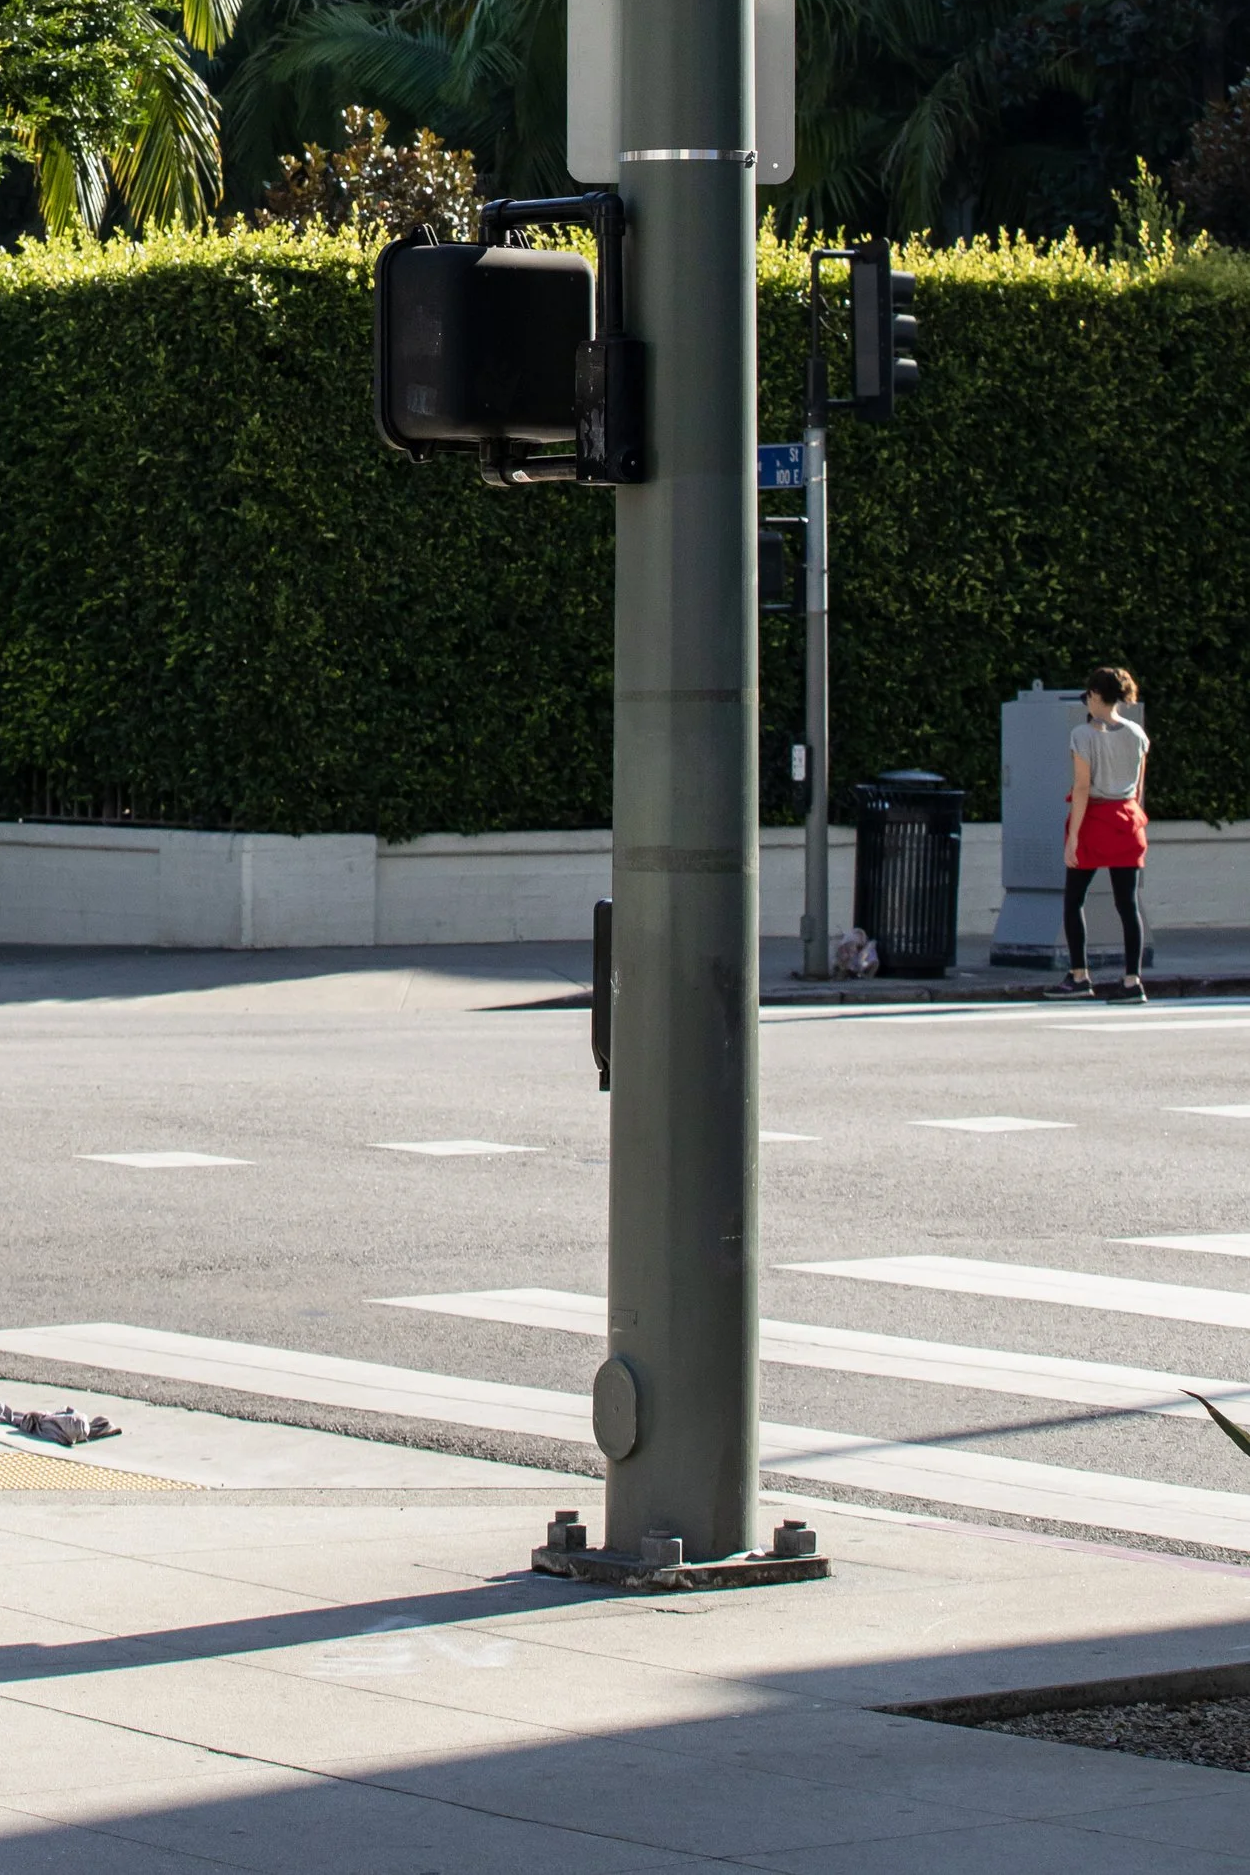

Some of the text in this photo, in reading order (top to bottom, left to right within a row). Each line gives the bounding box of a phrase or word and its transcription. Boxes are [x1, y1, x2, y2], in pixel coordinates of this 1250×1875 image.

[789, 447, 799, 462] St
[776, 469, 799, 485] 100 E
